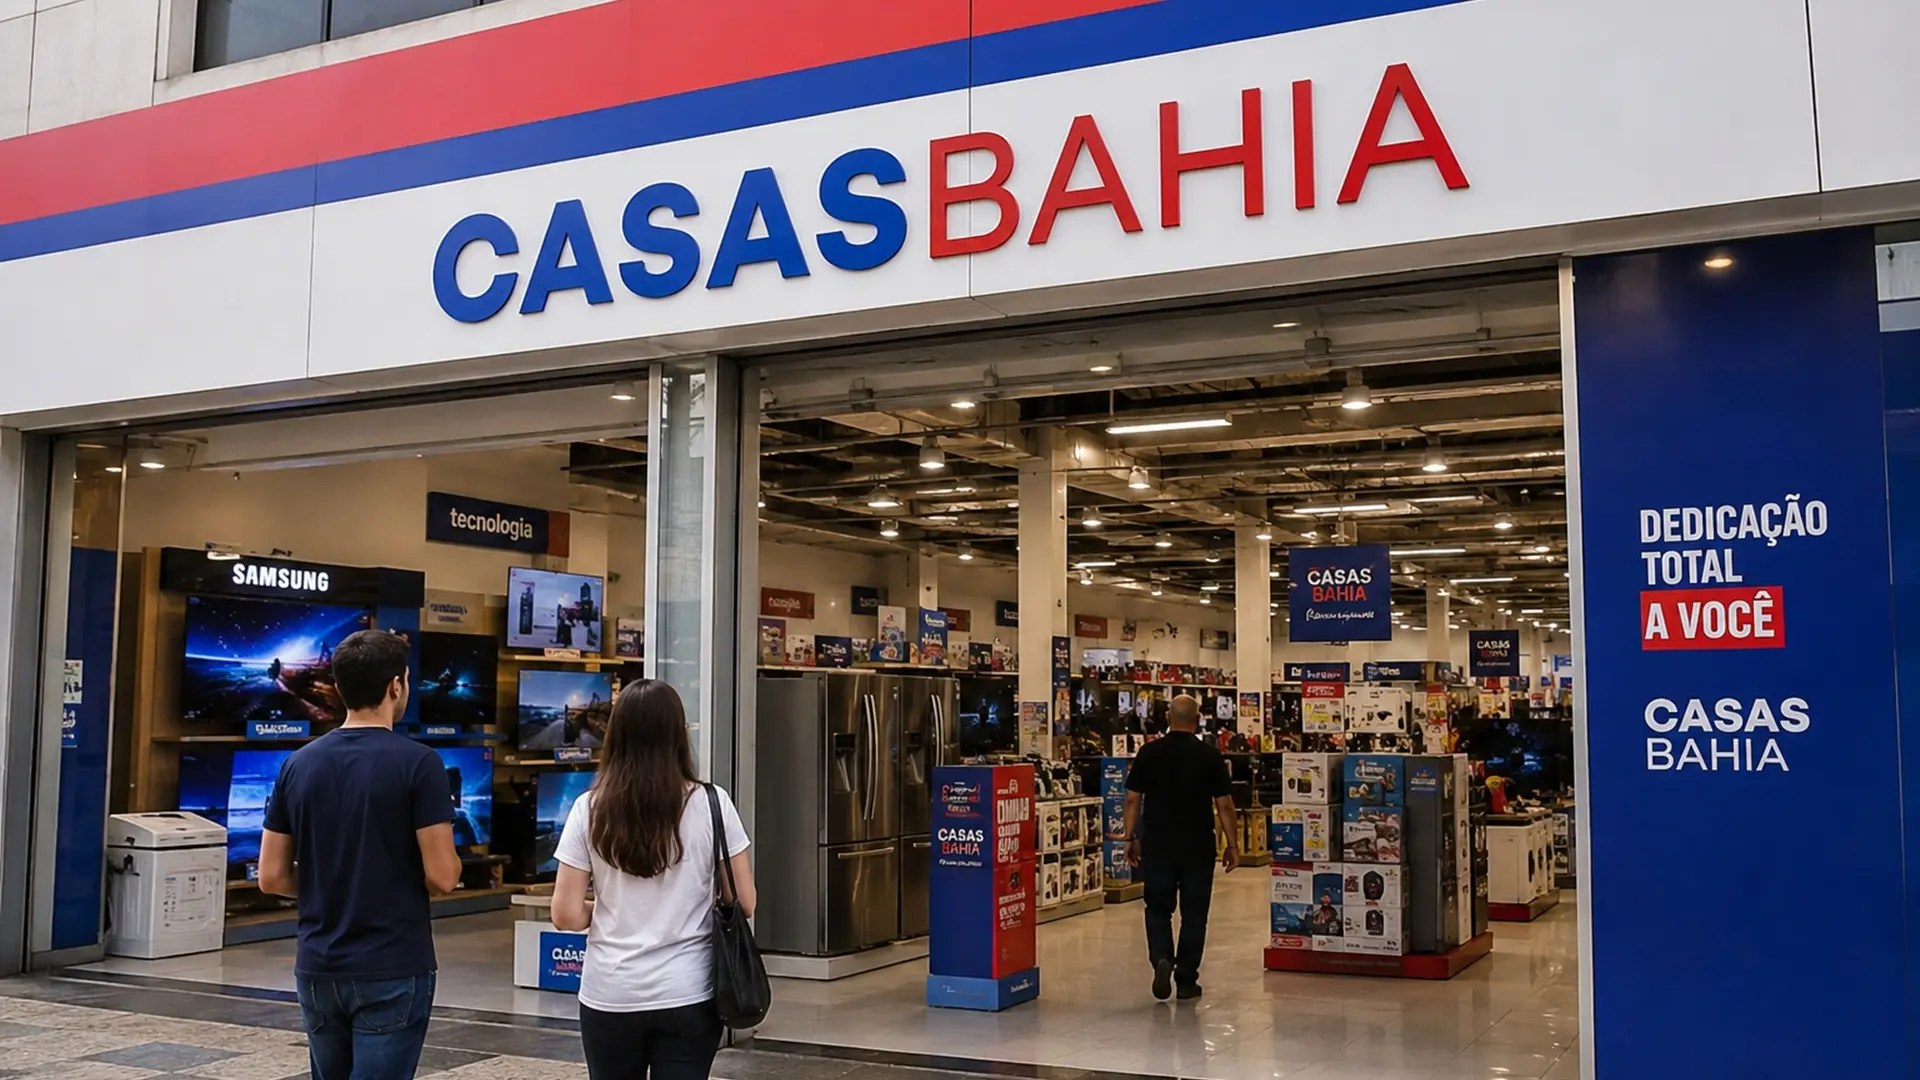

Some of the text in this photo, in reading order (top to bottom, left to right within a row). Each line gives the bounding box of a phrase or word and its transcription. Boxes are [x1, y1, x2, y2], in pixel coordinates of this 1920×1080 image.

[433, 62, 1471, 324] CASAS BAHIA
[450, 507, 534, 541] tecnologia
[1640, 493, 1828, 547] DEDICAÇÃO
[232, 563, 329, 592] SAMSUNG
[1307, 567, 1373, 586] CASAS
[1641, 548, 1743, 585] TOTAL
[1312, 585, 1367, 602] BAHIA
[1644, 590, 1775, 640] A VOCÊ
[1644, 697, 1811, 734] CASAS
[1647, 737, 1790, 772] BAHIA
[937, 828, 984, 842] CASAS
[942, 841, 981, 856] BAHIA
